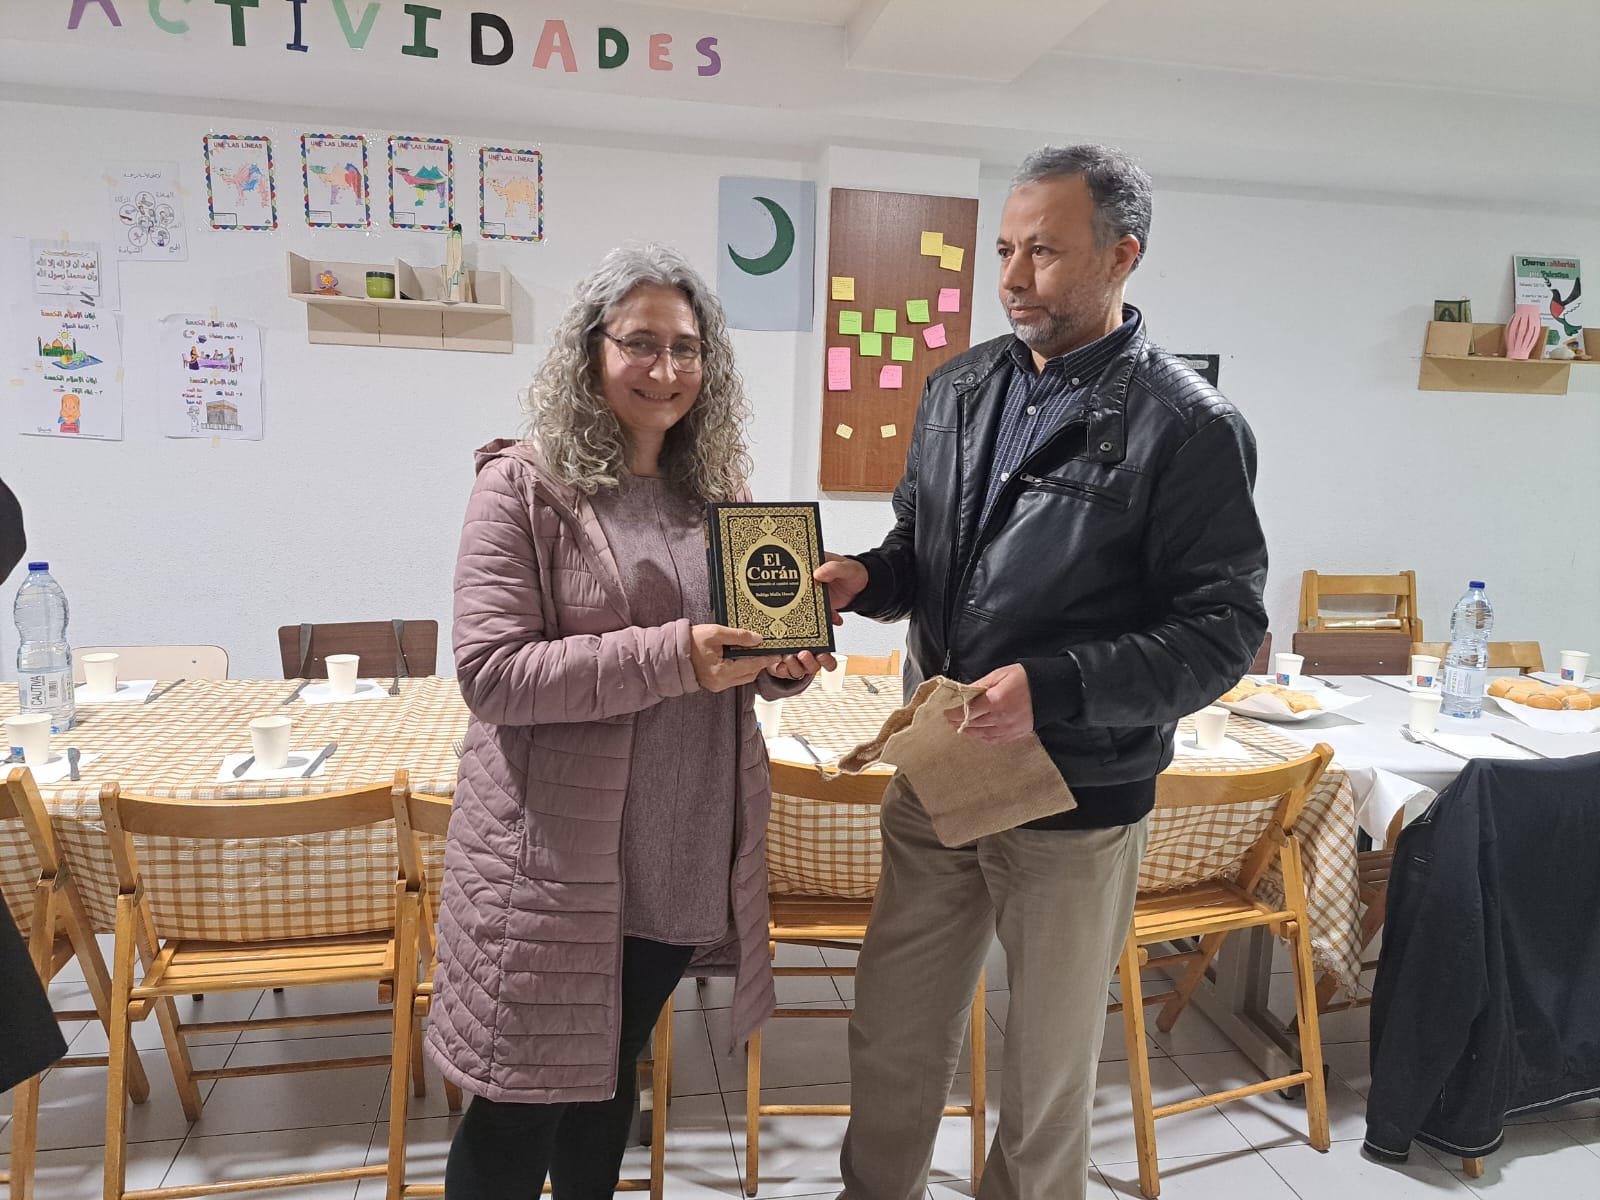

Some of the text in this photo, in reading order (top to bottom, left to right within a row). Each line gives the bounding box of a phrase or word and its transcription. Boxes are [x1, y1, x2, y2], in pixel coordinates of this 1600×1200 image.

[411, 143, 422, 151] LAS
[489, 154, 500, 162] UNE
[501, 154, 513, 162] LAS
[762, 553, 781, 566] El
[747, 566, 798, 580] Corán
[30, 675, 43, 706] CAUTIVA
